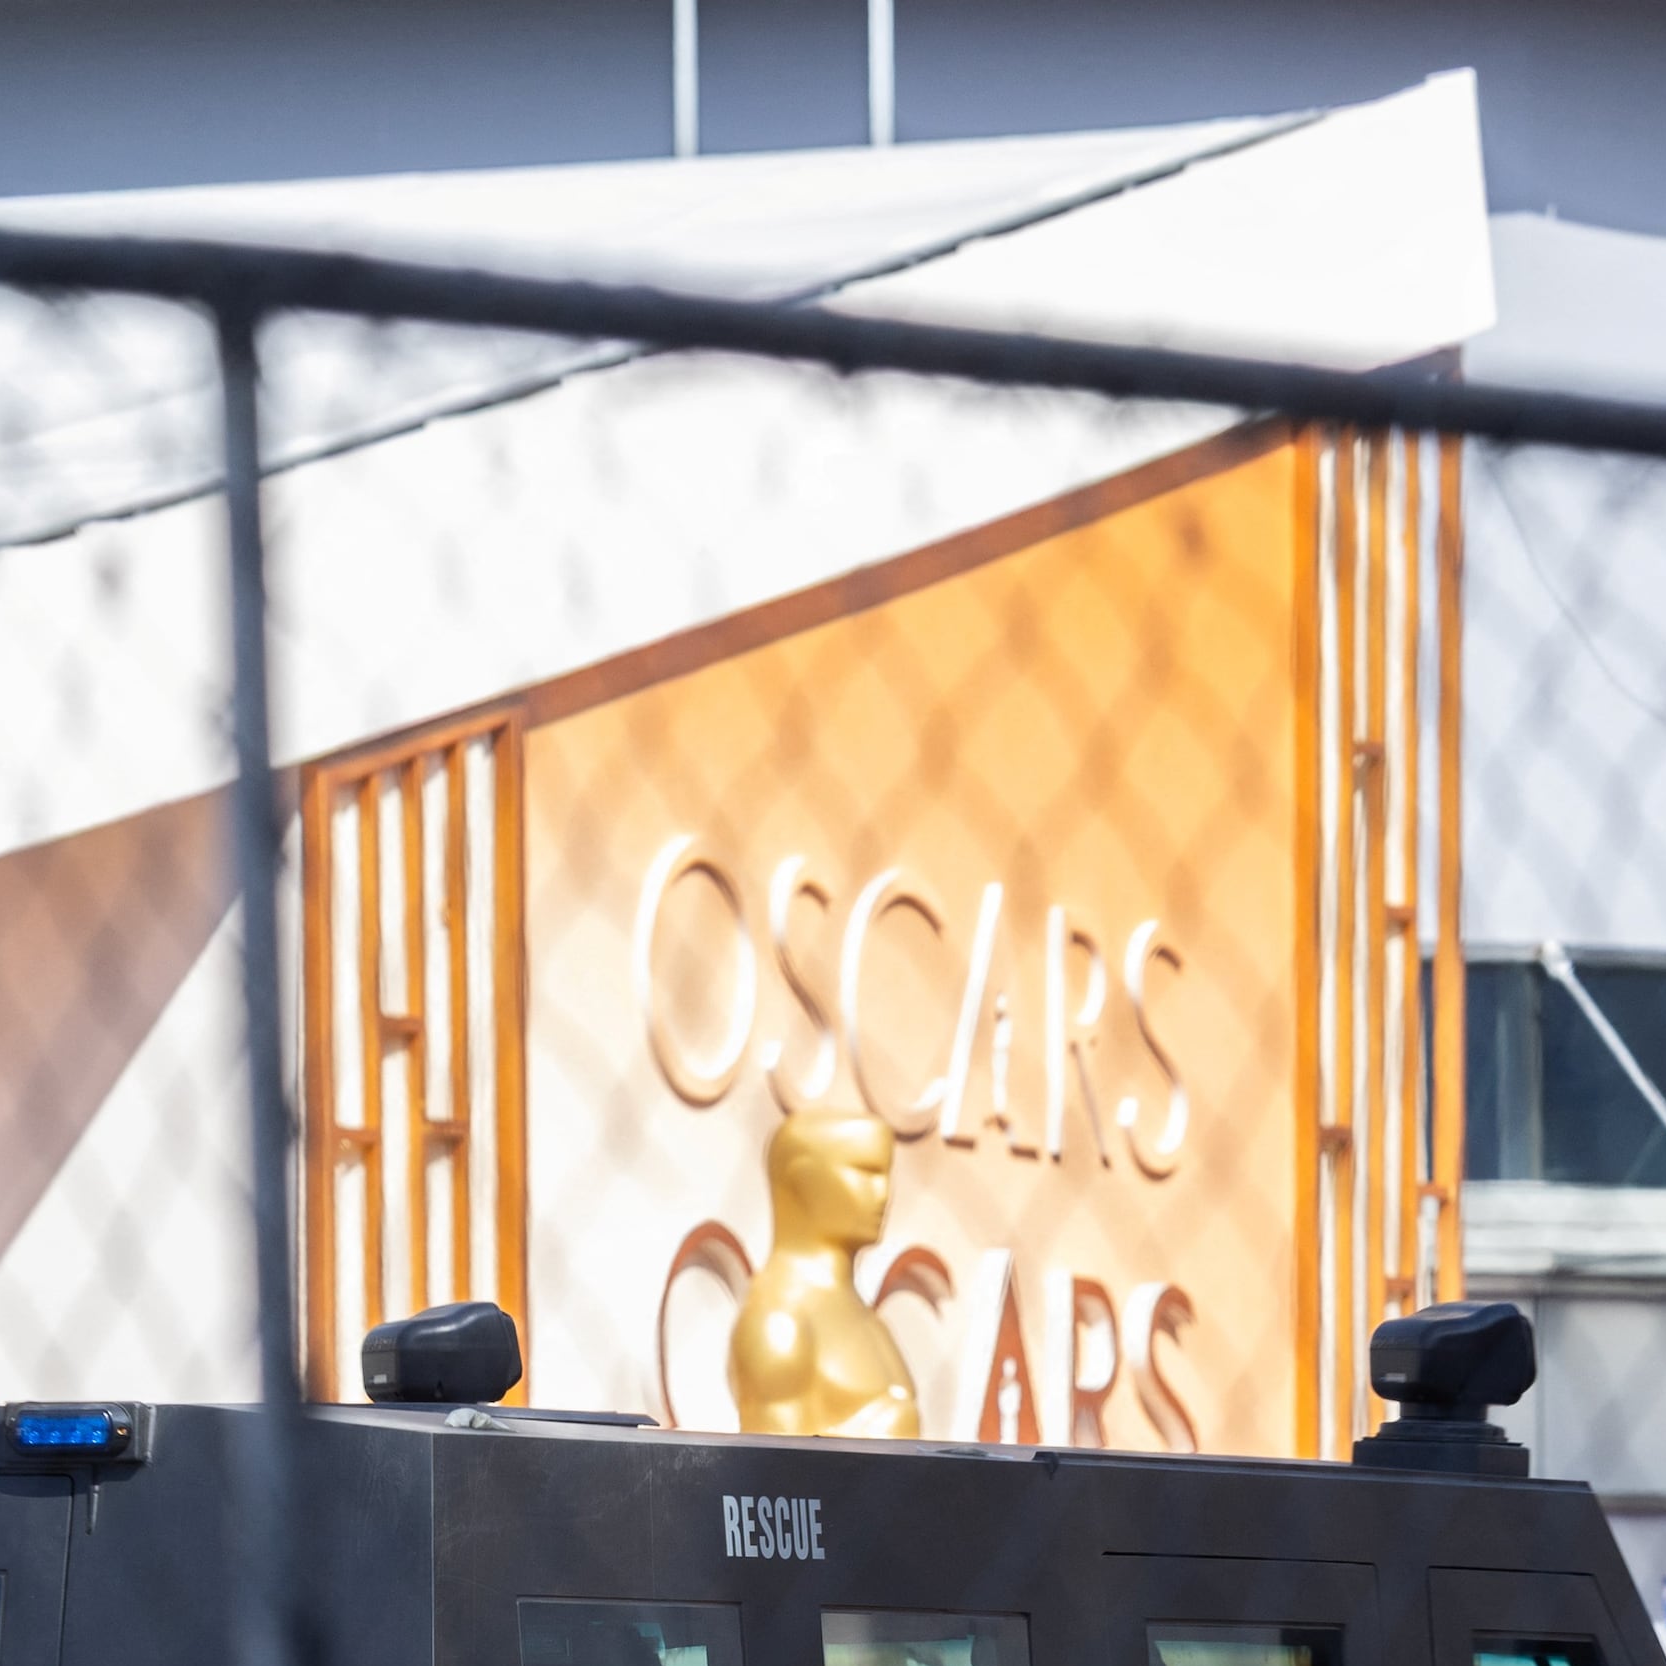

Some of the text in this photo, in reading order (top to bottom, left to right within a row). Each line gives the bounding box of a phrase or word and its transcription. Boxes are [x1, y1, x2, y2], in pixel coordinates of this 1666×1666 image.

[636, 834, 1189, 1182] OSCARS
[651, 1218, 1201, 1452] OARS
[723, 1495, 825, 1560] RESCUE
